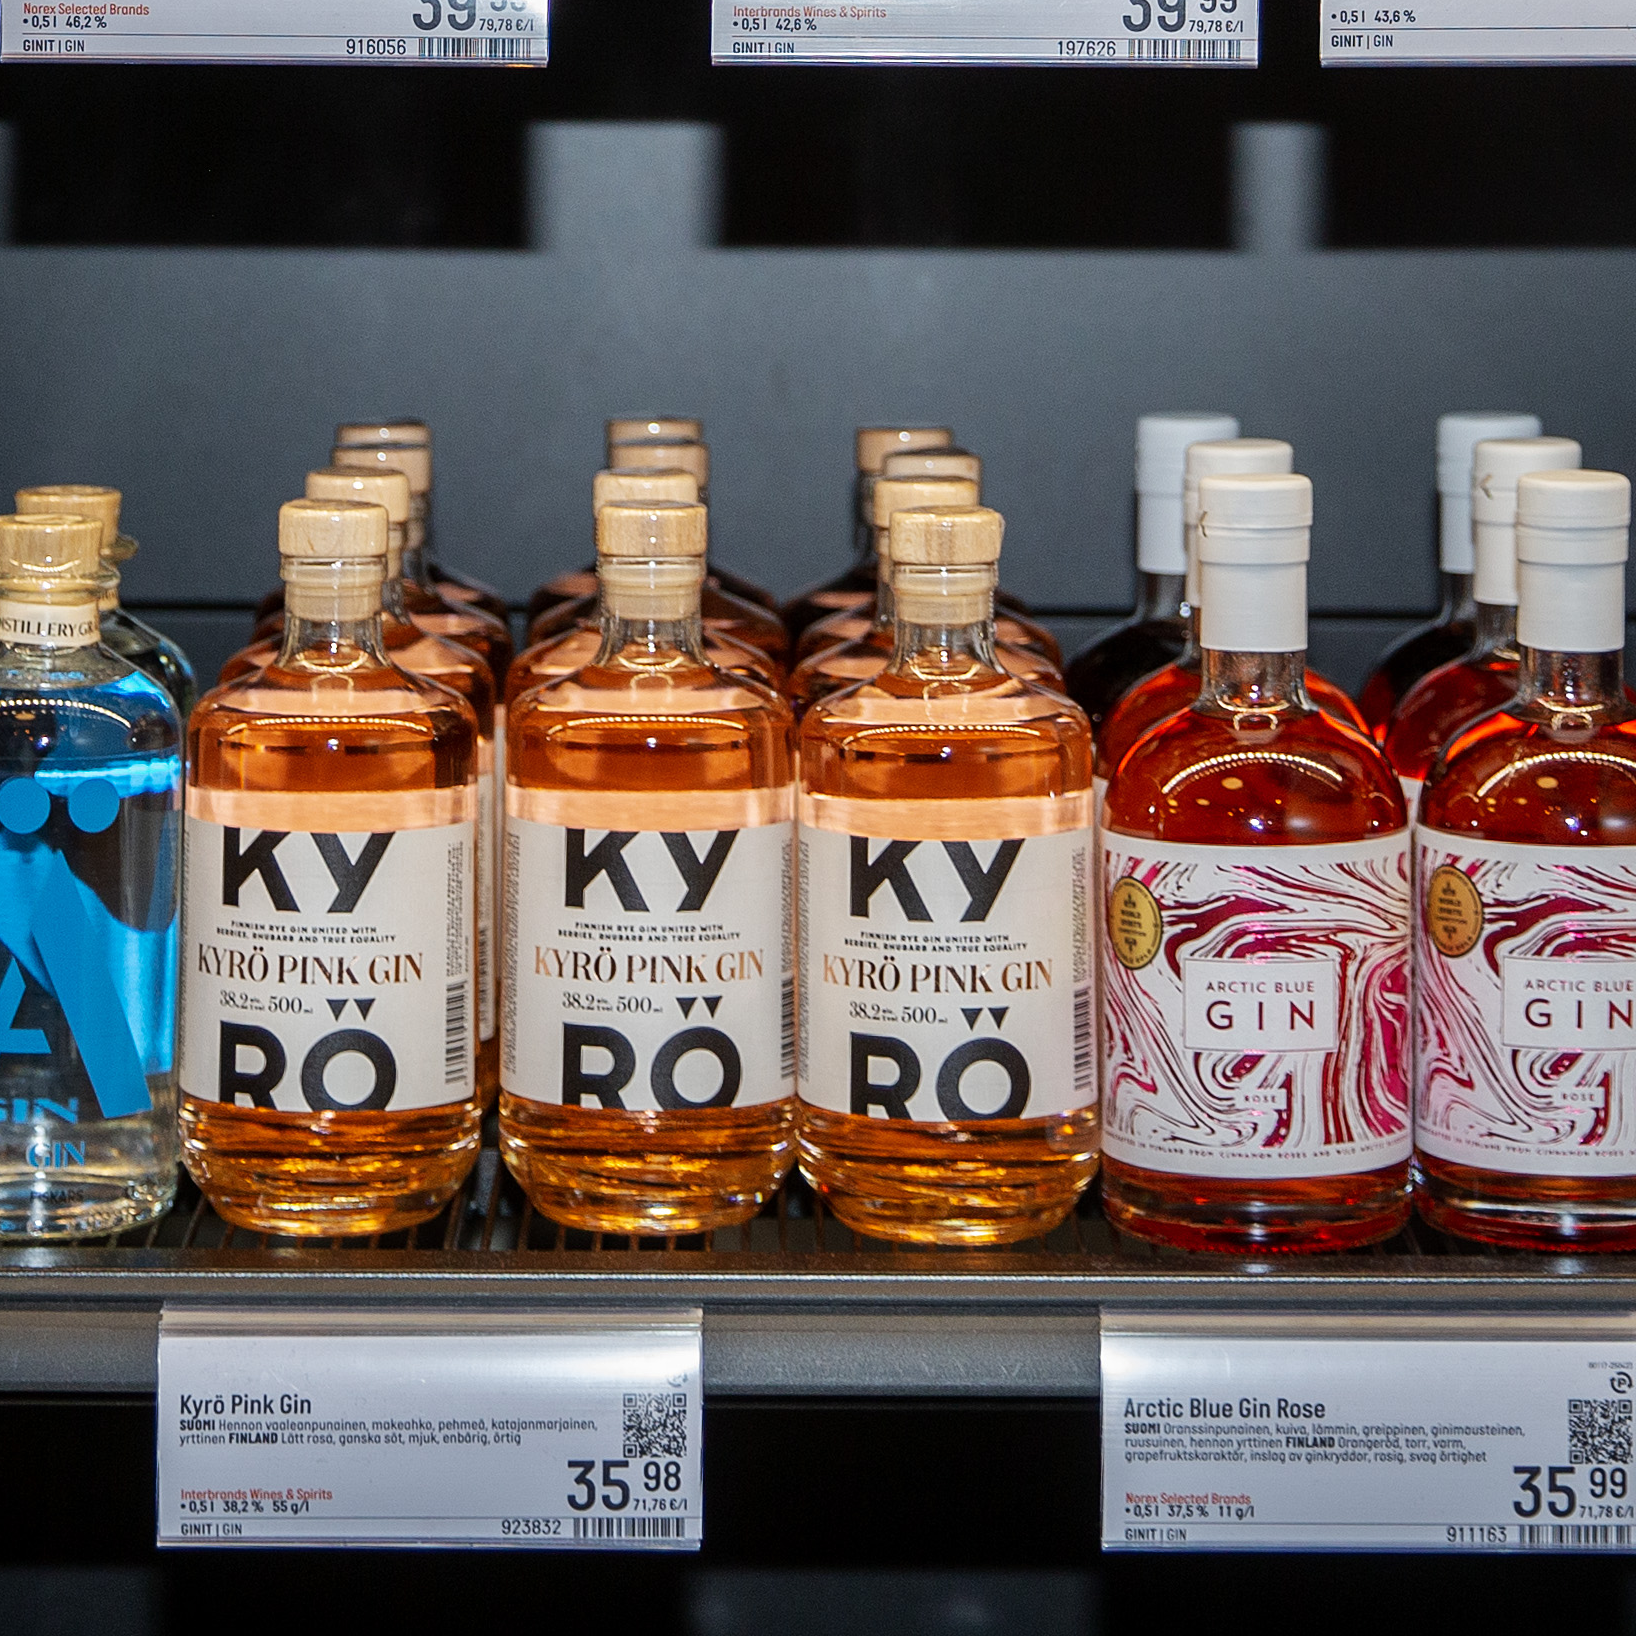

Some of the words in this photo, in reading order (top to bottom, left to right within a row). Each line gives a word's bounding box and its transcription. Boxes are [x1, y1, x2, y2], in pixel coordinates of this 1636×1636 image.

[199, 948, 270, 984] KYRÖ
[278, 953, 359, 985] PINK
[368, 952, 422, 984] GIN
[1206, 982, 1266, 993] ARCTIC
[1275, 981, 1314, 993] BLUE
[1206, 1001, 1316, 1031] GIN
[26, 1140, 86, 1169] GIN
[180, 1395, 224, 1420] Kyrö
[231, 1394, 274, 1414] Pink
[280, 1394, 311, 1414] Gin
[1124, 1398, 1183, 1418] Arctic
[1190, 1398, 1233, 1418] Blue
[1239, 1398, 1270, 1418] Gin
[1277, 1398, 1325, 1419] Rose
[567, 1460, 630, 1511] 35
[644, 1461, 681, 1492] 98
[1513, 1466, 1576, 1518] 35
[1590, 1467, 1627, 1499] 99
[501, 1519, 561, 1535] 923832
